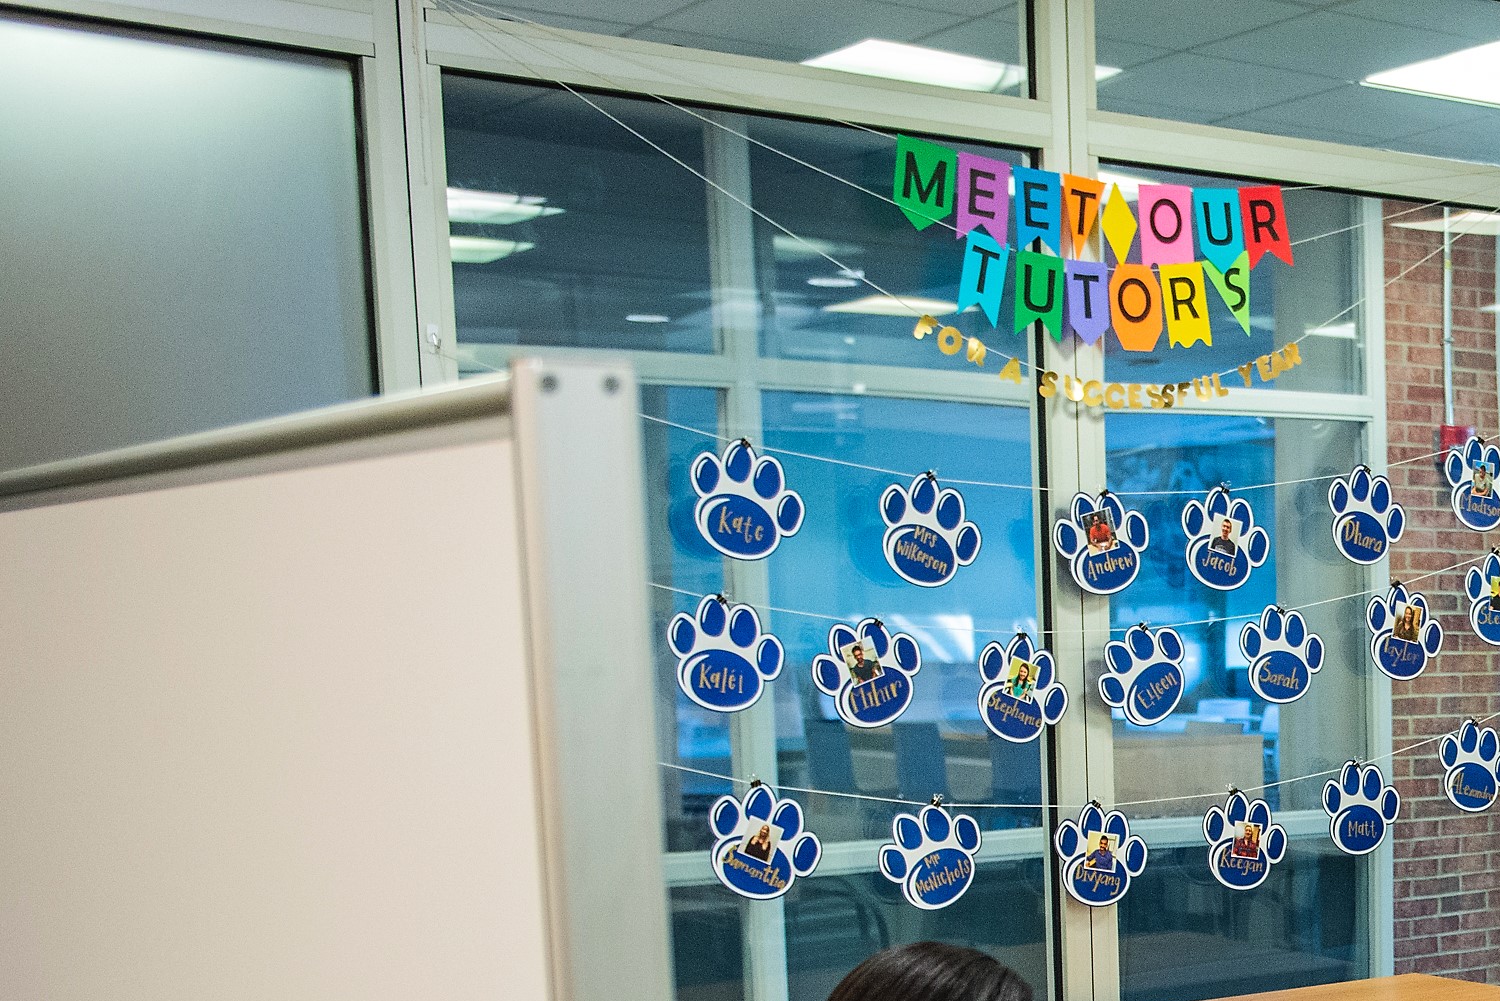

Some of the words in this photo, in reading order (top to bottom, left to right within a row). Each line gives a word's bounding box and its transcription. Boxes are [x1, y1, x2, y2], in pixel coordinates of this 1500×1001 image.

[902, 151, 1099, 236] MEET
[1149, 197, 1281, 246] OUR
[971, 245, 1247, 323] TUTORS
[913, 314, 987, 368] FOR
[1000, 357, 1022, 384] A
[1039, 370, 1229, 409] SUCCESSFUL
[1237, 342, 1302, 387] YEAR
[717, 505, 765, 544] Kate
[914, 526, 937, 547] Mrs
[1344, 519, 1383, 554] Dhara
[896, 540, 948, 577] Wilkerson
[1087, 552, 1134, 581] Andrew
[1202, 551, 1237, 577] Jacob
[1383, 636, 1421, 667] Taylor
[1137, 671, 1178, 709] Eileen
[1259, 662, 1300, 691] Sarah
[987, 691, 1043, 728] Stephanie
[1347, 819, 1377, 840] Matt
[722, 844, 788, 890] Samantha
[915, 857, 971, 896] McNichols
[923, 853, 940, 869] Mr
[1219, 848, 1263, 876] Keegan
[1075, 864, 1121, 896] Divyang
